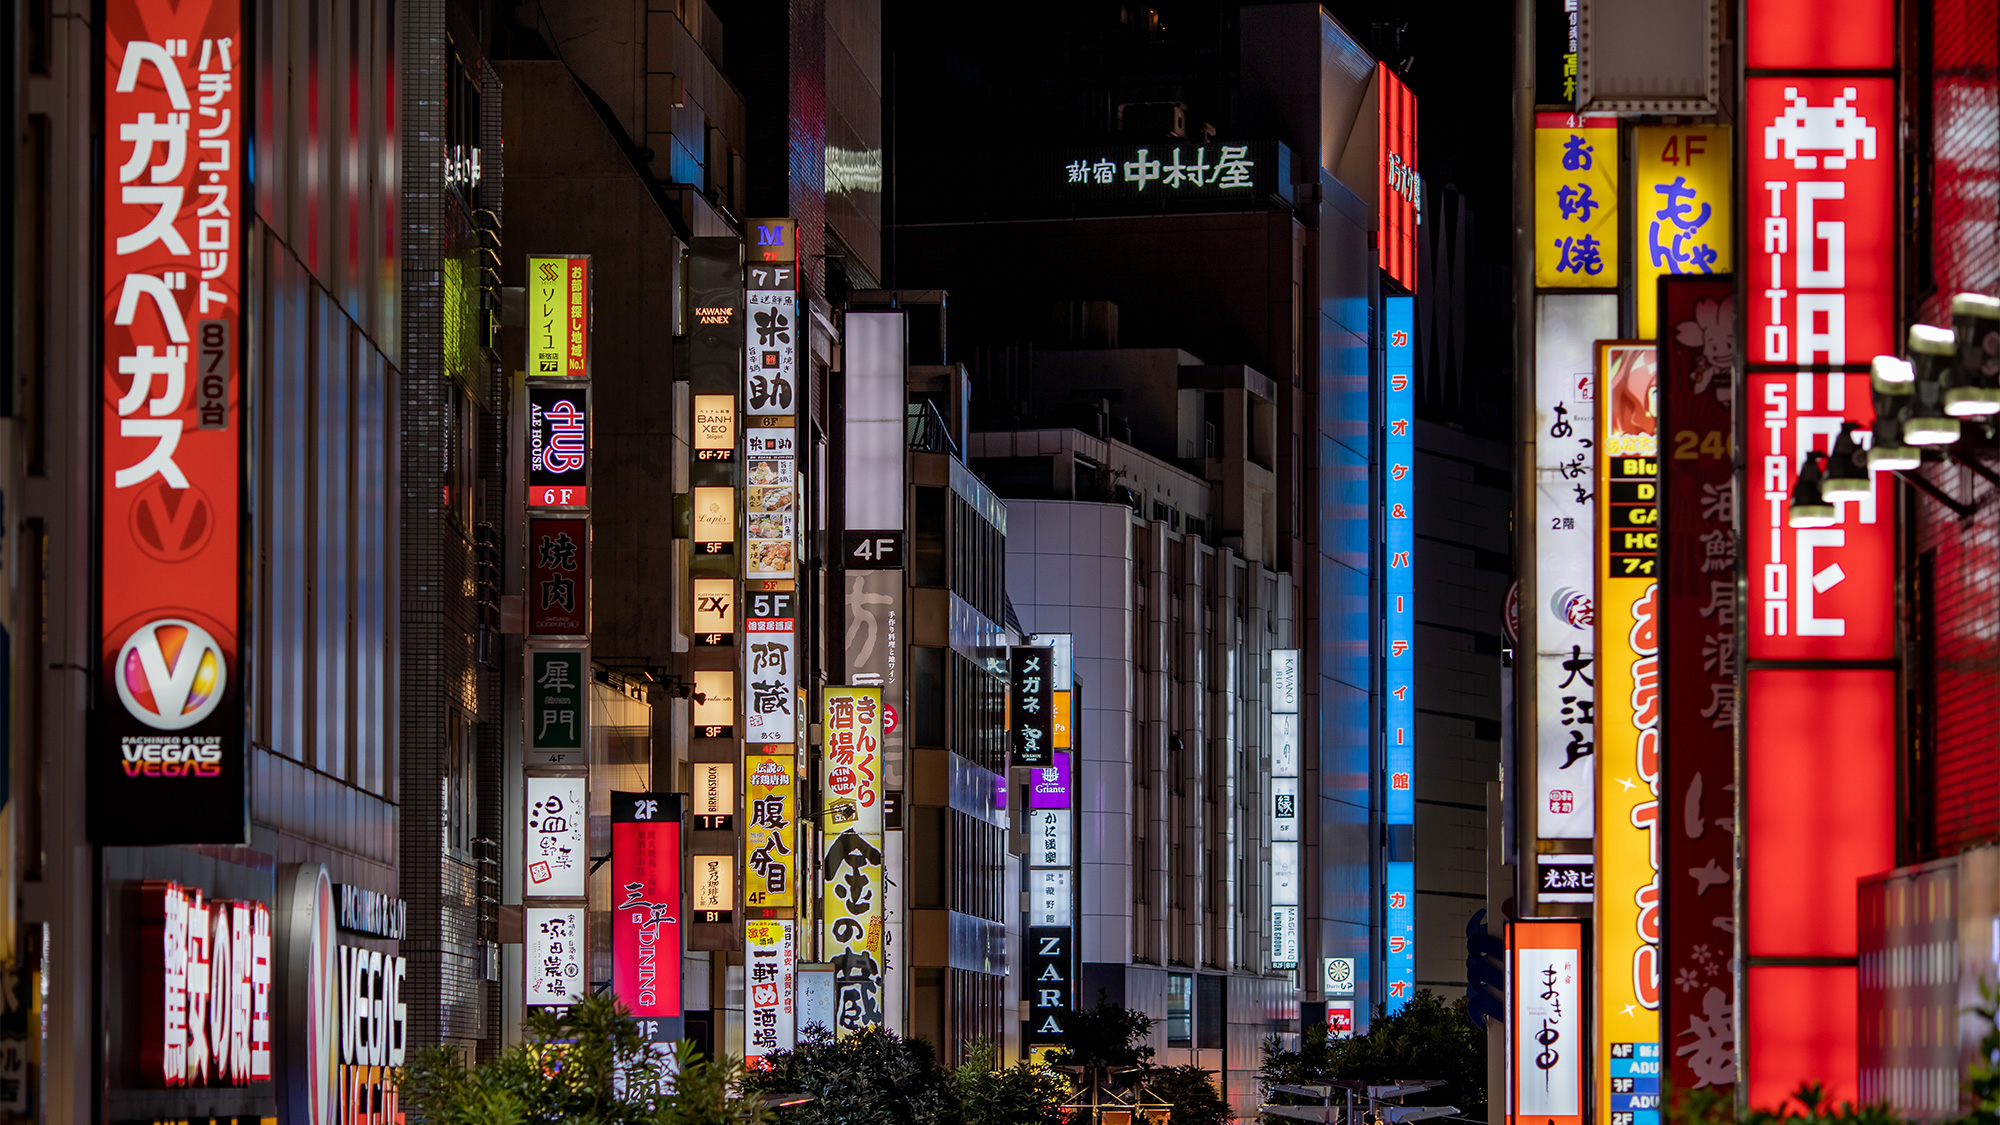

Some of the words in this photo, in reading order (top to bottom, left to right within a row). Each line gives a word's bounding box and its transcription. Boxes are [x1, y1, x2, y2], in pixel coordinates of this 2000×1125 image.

[1661, 135, 1708, 167] 4F
[197, 37, 233, 314] パチンコ・スロット
[1065, 157, 1117, 184] 新宿
[1123, 145, 1254, 192] 中村屋
[1554, 134, 1604, 276] お好焼
[757, 225, 784, 246] M
[1648, 176, 1718, 274] もんじゃ
[115, 40, 192, 488] ベガスベガス
[763, 252, 779, 262] 7F
[1764, 181, 1788, 361] TAITO
[543, 288, 555, 349] ソレイユ
[571, 266, 582, 357] お部屋探し地域
[695, 307, 733, 316] KAWANE
[700, 316, 729, 324] ANNEX
[541, 362, 557, 371] 7F
[569, 359, 584, 370] No.1
[783, 346, 793, 374] 串焼き
[200, 323, 227, 429] 876台
[532, 403, 542, 427] ALE
[697, 415, 732, 423] BANH
[763, 417, 778, 426] 6F
[543, 400, 584, 474] HUB
[702, 425, 727, 433] XEO
[532, 429, 542, 471] HOUSE
[1550, 401, 1593, 505] あっぱれ
[698, 514, 727, 524] Lapis
[1764, 383, 1788, 636] STATION
[1552, 517, 1575, 530] 2階
[706, 543, 722, 553] 5F
[750, 544, 759, 568] 串焼き
[853, 538, 895, 561] 4F
[538, 532, 577, 613] 焼肉
[763, 581, 777, 590] 5F
[698, 597, 730, 619] ZXY
[754, 595, 790, 617] 5F
[705, 634, 721, 645] 4F
[750, 642, 791, 715] 阿蔵
[1022, 656, 1041, 713] メガネ
[1285, 658, 1295, 704] KAWANO
[1558, 645, 1594, 770] 大江戸
[122, 736, 179, 745] PACHINKO
[193, 736, 222, 745] SLOT
[705, 727, 721, 737] 3F
[829, 696, 854, 766] 酒場
[121, 744, 222, 762] VEGAS
[549, 754, 565, 763] 4F
[762, 745, 778, 753] 4F
[856, 696, 877, 808] きんくら
[121, 760, 222, 777] VEGAS
[756, 763, 785, 774] 伝説の
[832, 768, 850, 777] KIN
[708, 766, 717, 812] BIRKENSTOCK
[831, 783, 855, 792] KURA
[1036, 785, 1065, 793] Griante
[634, 799, 658, 820] 2F
[749, 794, 792, 893] 腹八分目
[708, 861, 719, 906] 星乃珈琲店
[749, 892, 766, 904] 4F
[1045, 873, 1055, 923] 武蔵野館
[341, 883, 382, 933] PACHINKO
[389, 895, 407, 941] SLOT
[706, 912, 719, 922] B1
[762, 909, 777, 918] 3F
[748, 927, 769, 939] 激安
[825, 828, 882, 1031] 金の蔵
[540, 918, 567, 997] 塚田農場
[638, 929, 656, 1007] DINING
[1037, 937, 1064, 1033] ZARA
[340, 945, 407, 1066] VEGAS
[752, 950, 779, 1049] 一軒め酒場
[1612, 1043, 1633, 1057] 4F
[1613, 1079, 1633, 1092] 3F
[1614, 1114, 1633, 1125] 2F
